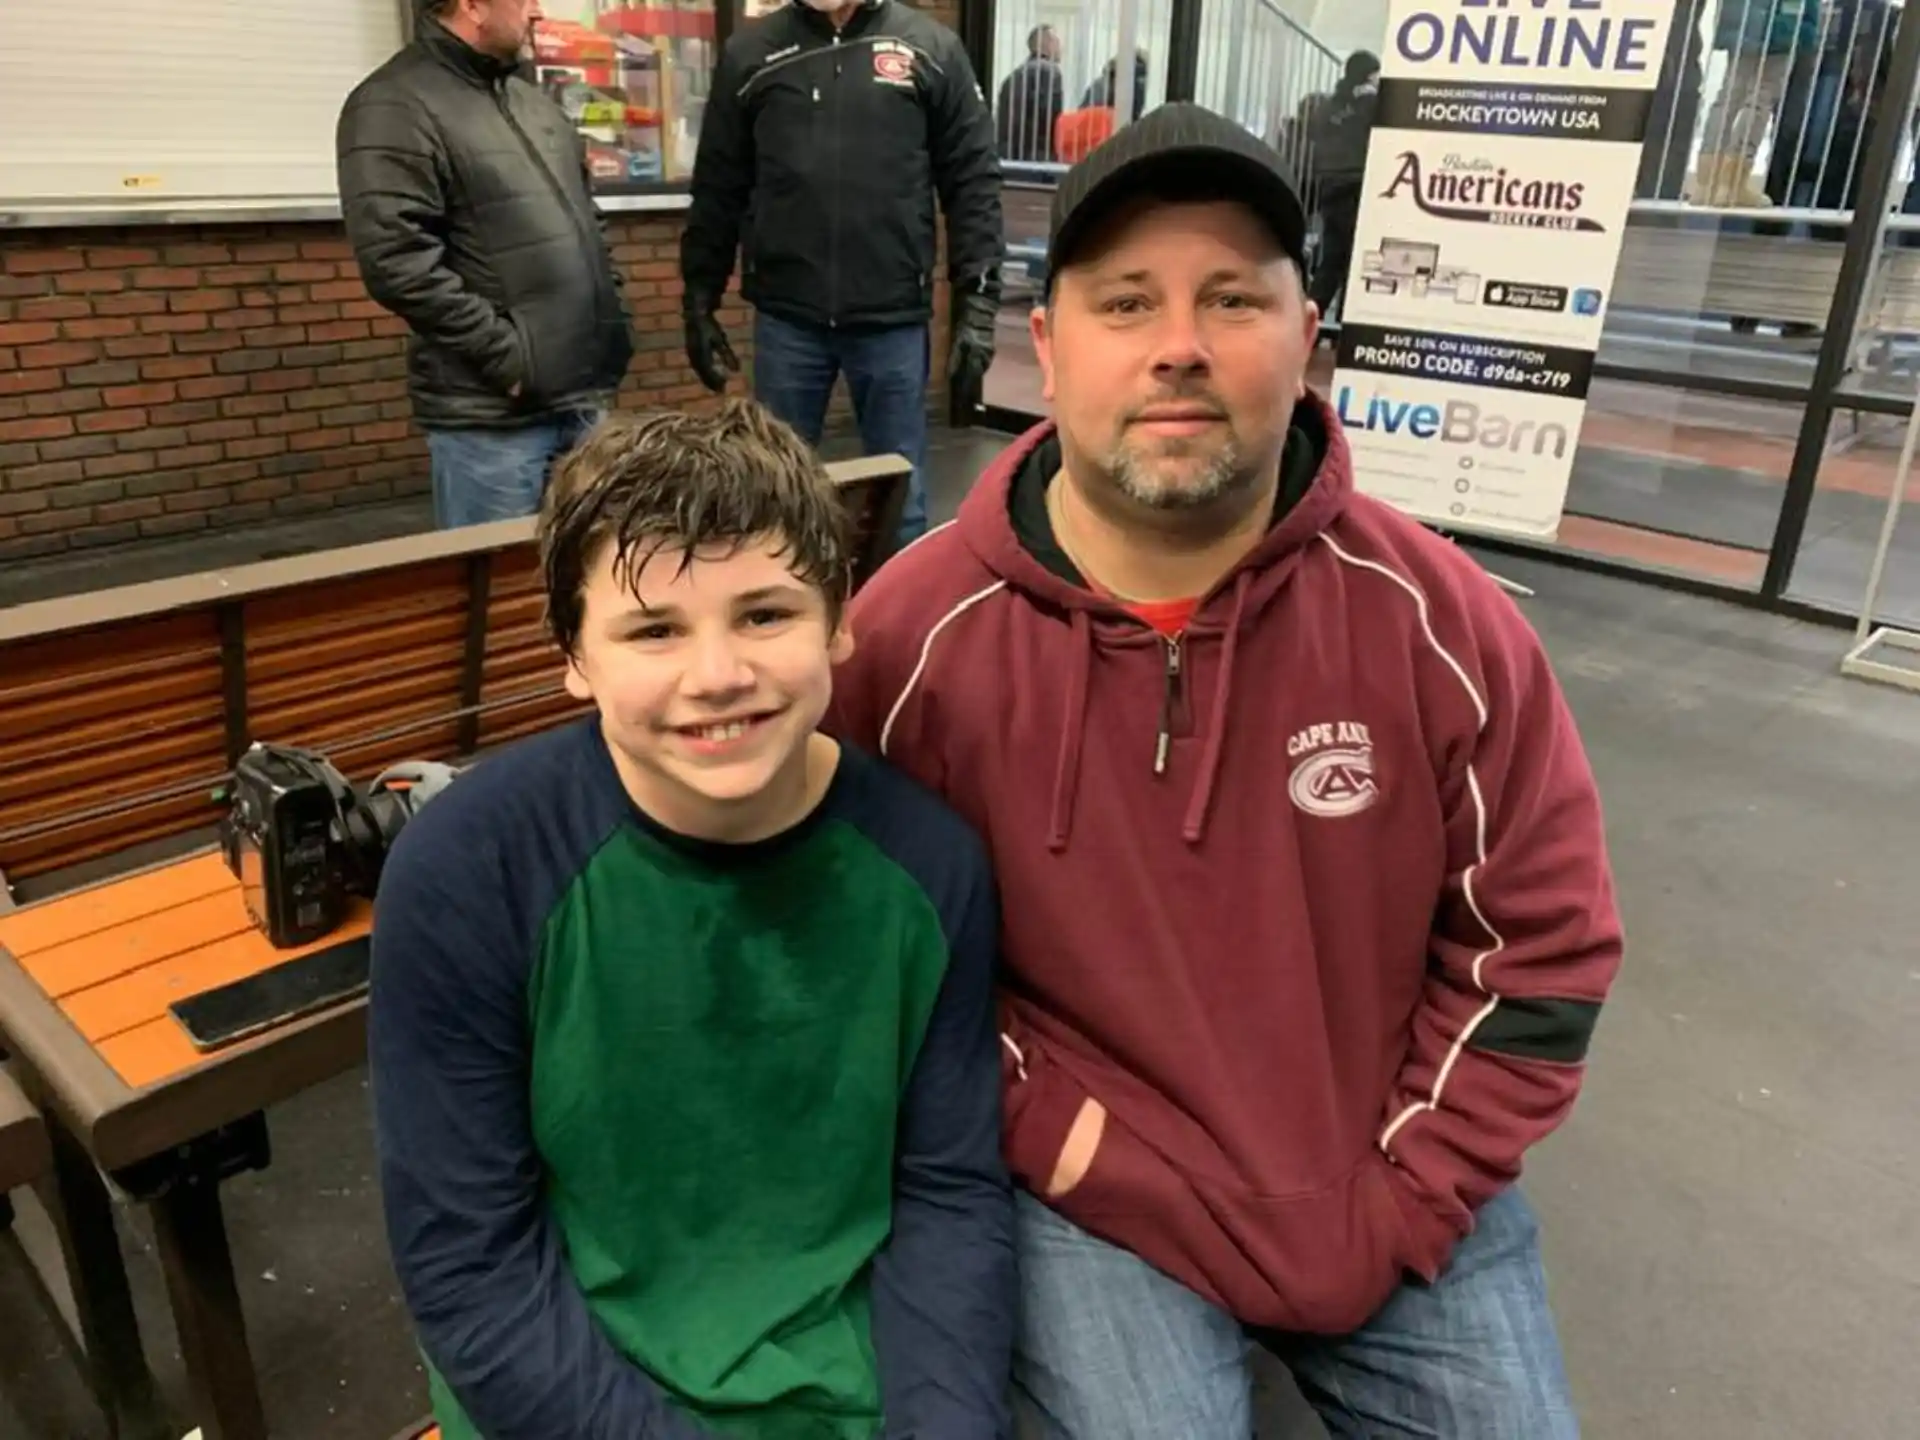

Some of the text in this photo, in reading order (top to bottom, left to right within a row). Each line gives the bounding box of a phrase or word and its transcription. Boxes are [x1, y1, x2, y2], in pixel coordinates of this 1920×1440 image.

[1396, 13, 1656, 71] ONLINE
[1416, 102, 1601, 129] HOCKEYTOWN USA
[1378, 150, 1586, 213] Americans
[1354, 345, 1571, 388] PROMO CODE: d9da-c7f9
[1384, 333, 1412, 347] SAVE
[1439, 340, 1457, 352] ON
[1460, 343, 1546, 365] SUBSCRIPTION
[1337, 385, 1567, 459] LiveBarn
[1287, 722, 1334, 757] CAPE
